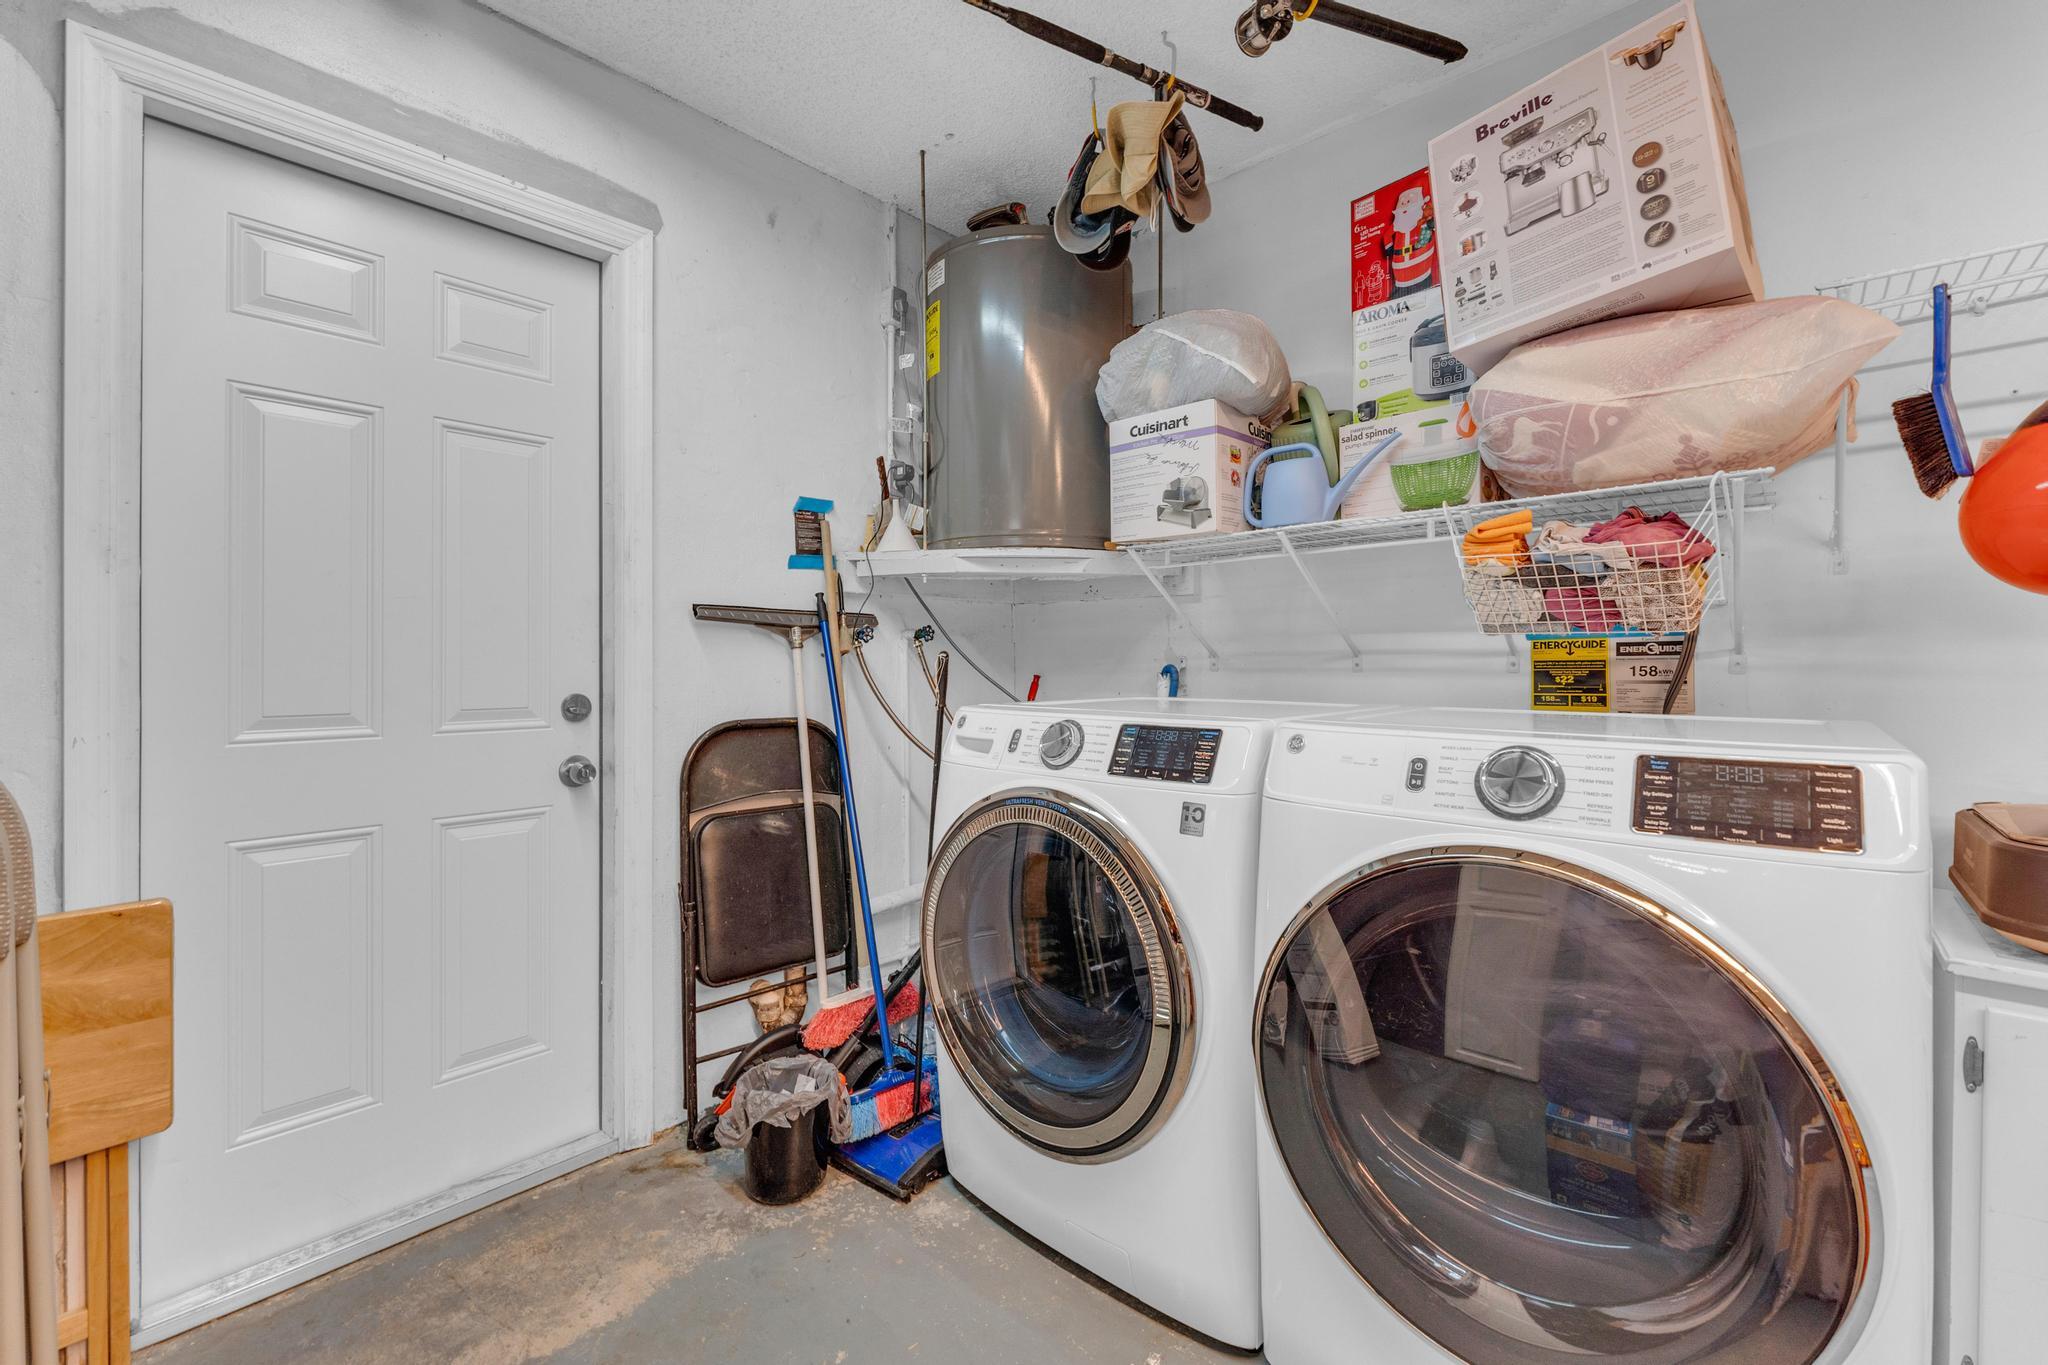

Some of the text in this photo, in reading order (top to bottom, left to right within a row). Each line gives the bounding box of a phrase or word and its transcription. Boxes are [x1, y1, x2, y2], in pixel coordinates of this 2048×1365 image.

[1475, 94, 1553, 143] Breville
[1357, 300, 1411, 326] AROMA
[1130, 414, 1189, 438] Cuisinart
[1248, 421, 1272, 442] Cuisin
[1341, 431, 1363, 444] salad
[1365, 426, 1398, 440] spinner
[1533, 640, 1607, 650] ENERGYGUIDE
[1629, 665, 1658, 677] 158
[1554, 675, 1575, 683] $22
[1050, 802, 1068, 814] SYSTEM
[1776, 832, 1792, 840] Time
[1826, 836, 1844, 844] Light
